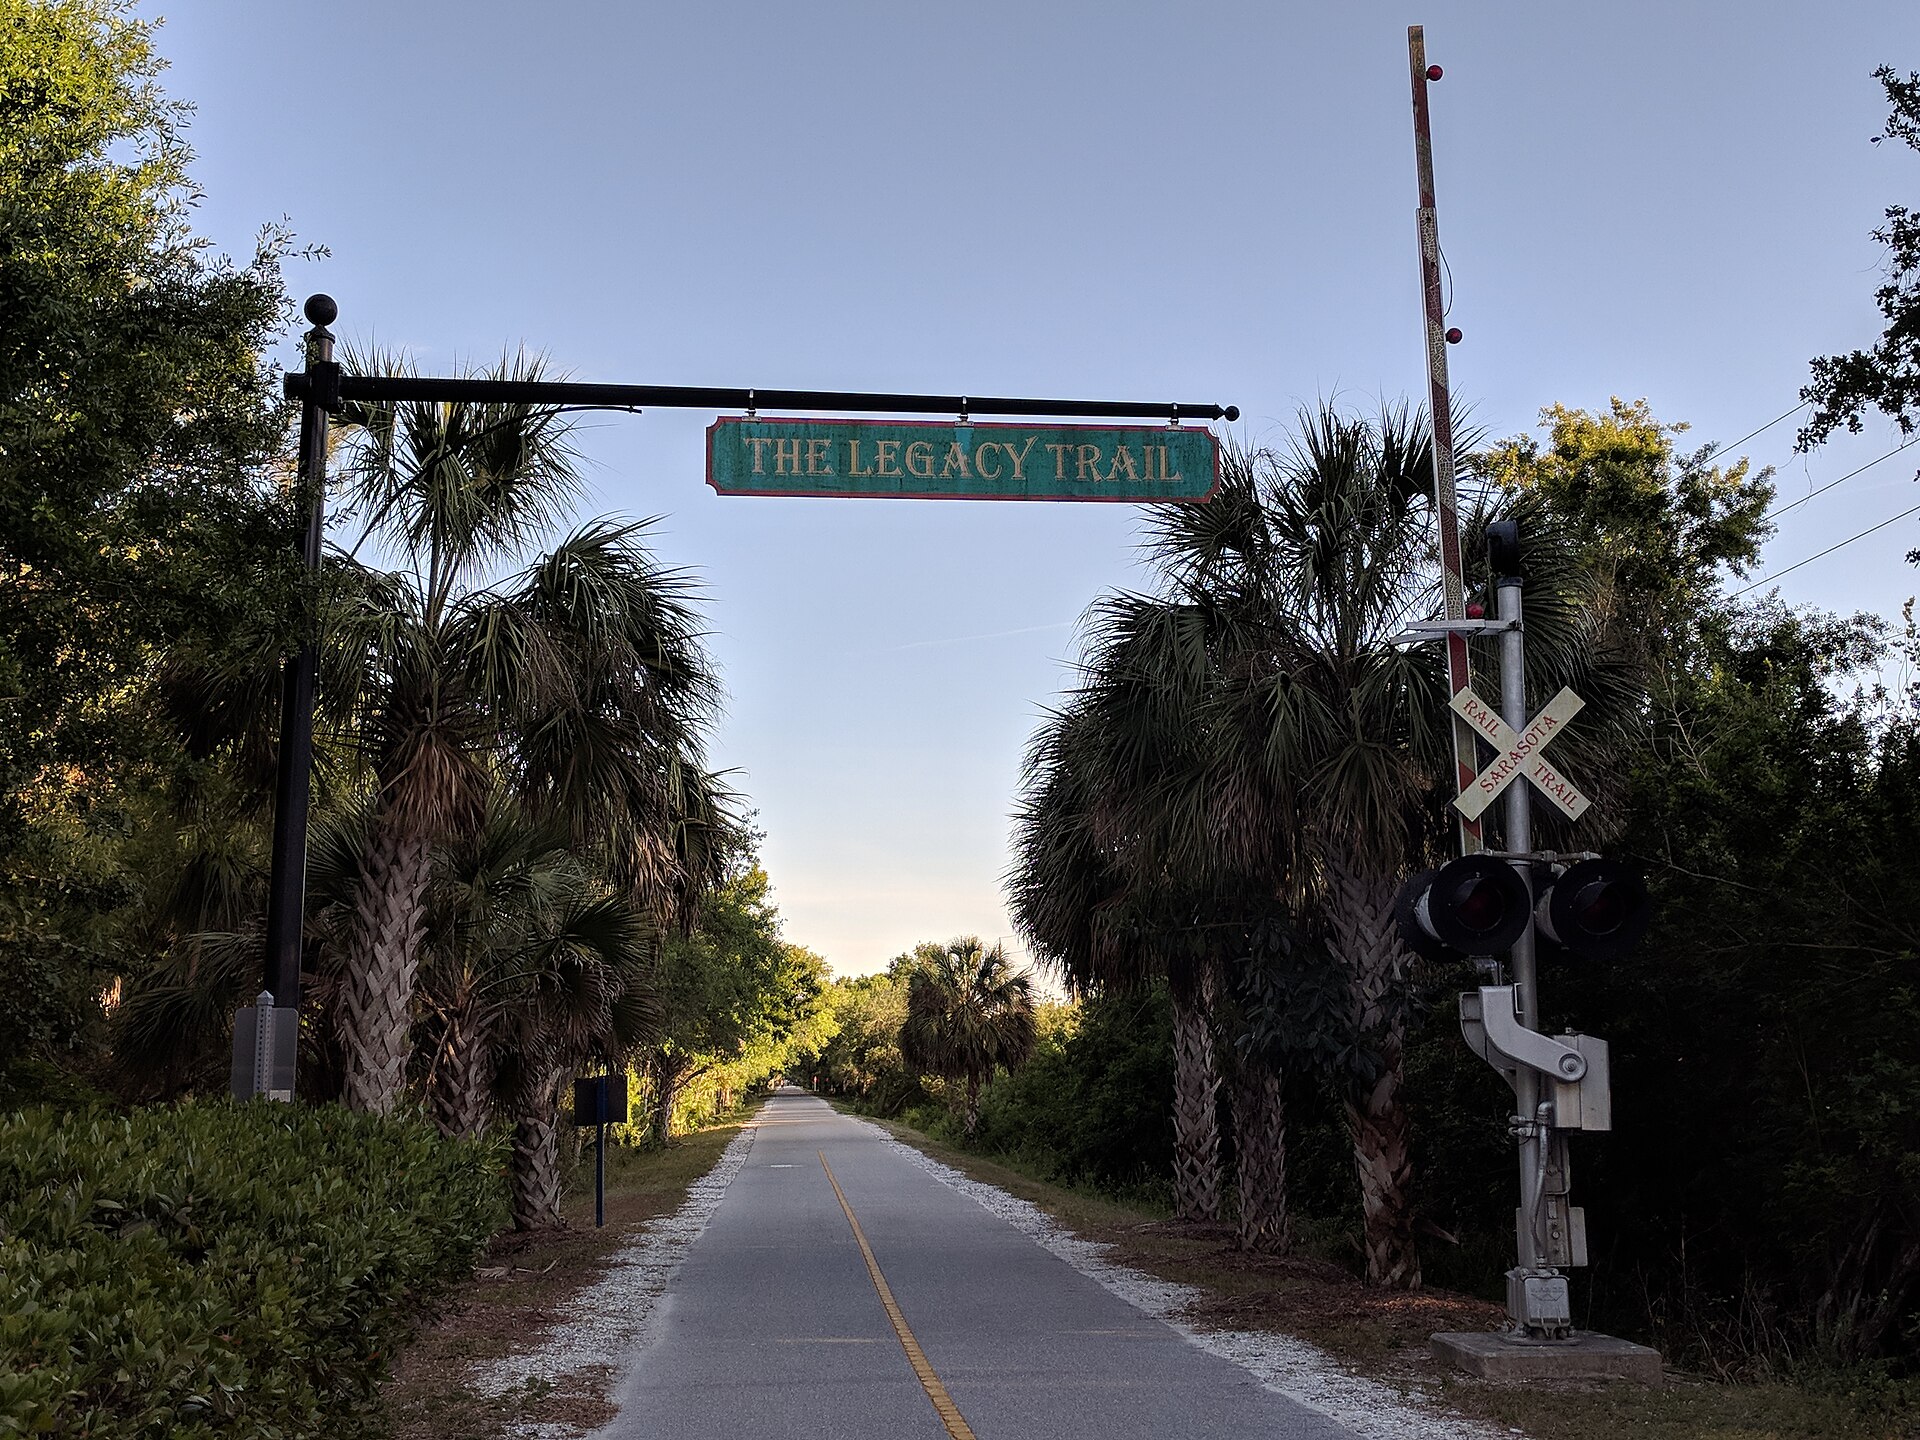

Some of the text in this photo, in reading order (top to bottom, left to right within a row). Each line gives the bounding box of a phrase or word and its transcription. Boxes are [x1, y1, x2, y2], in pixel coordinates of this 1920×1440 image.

[743, 436, 1184, 483] THE LEGACY TRAIL
[1462, 699, 1580, 811] RAIL TRAIL
[1479, 715, 1559, 793] SARASOTA
